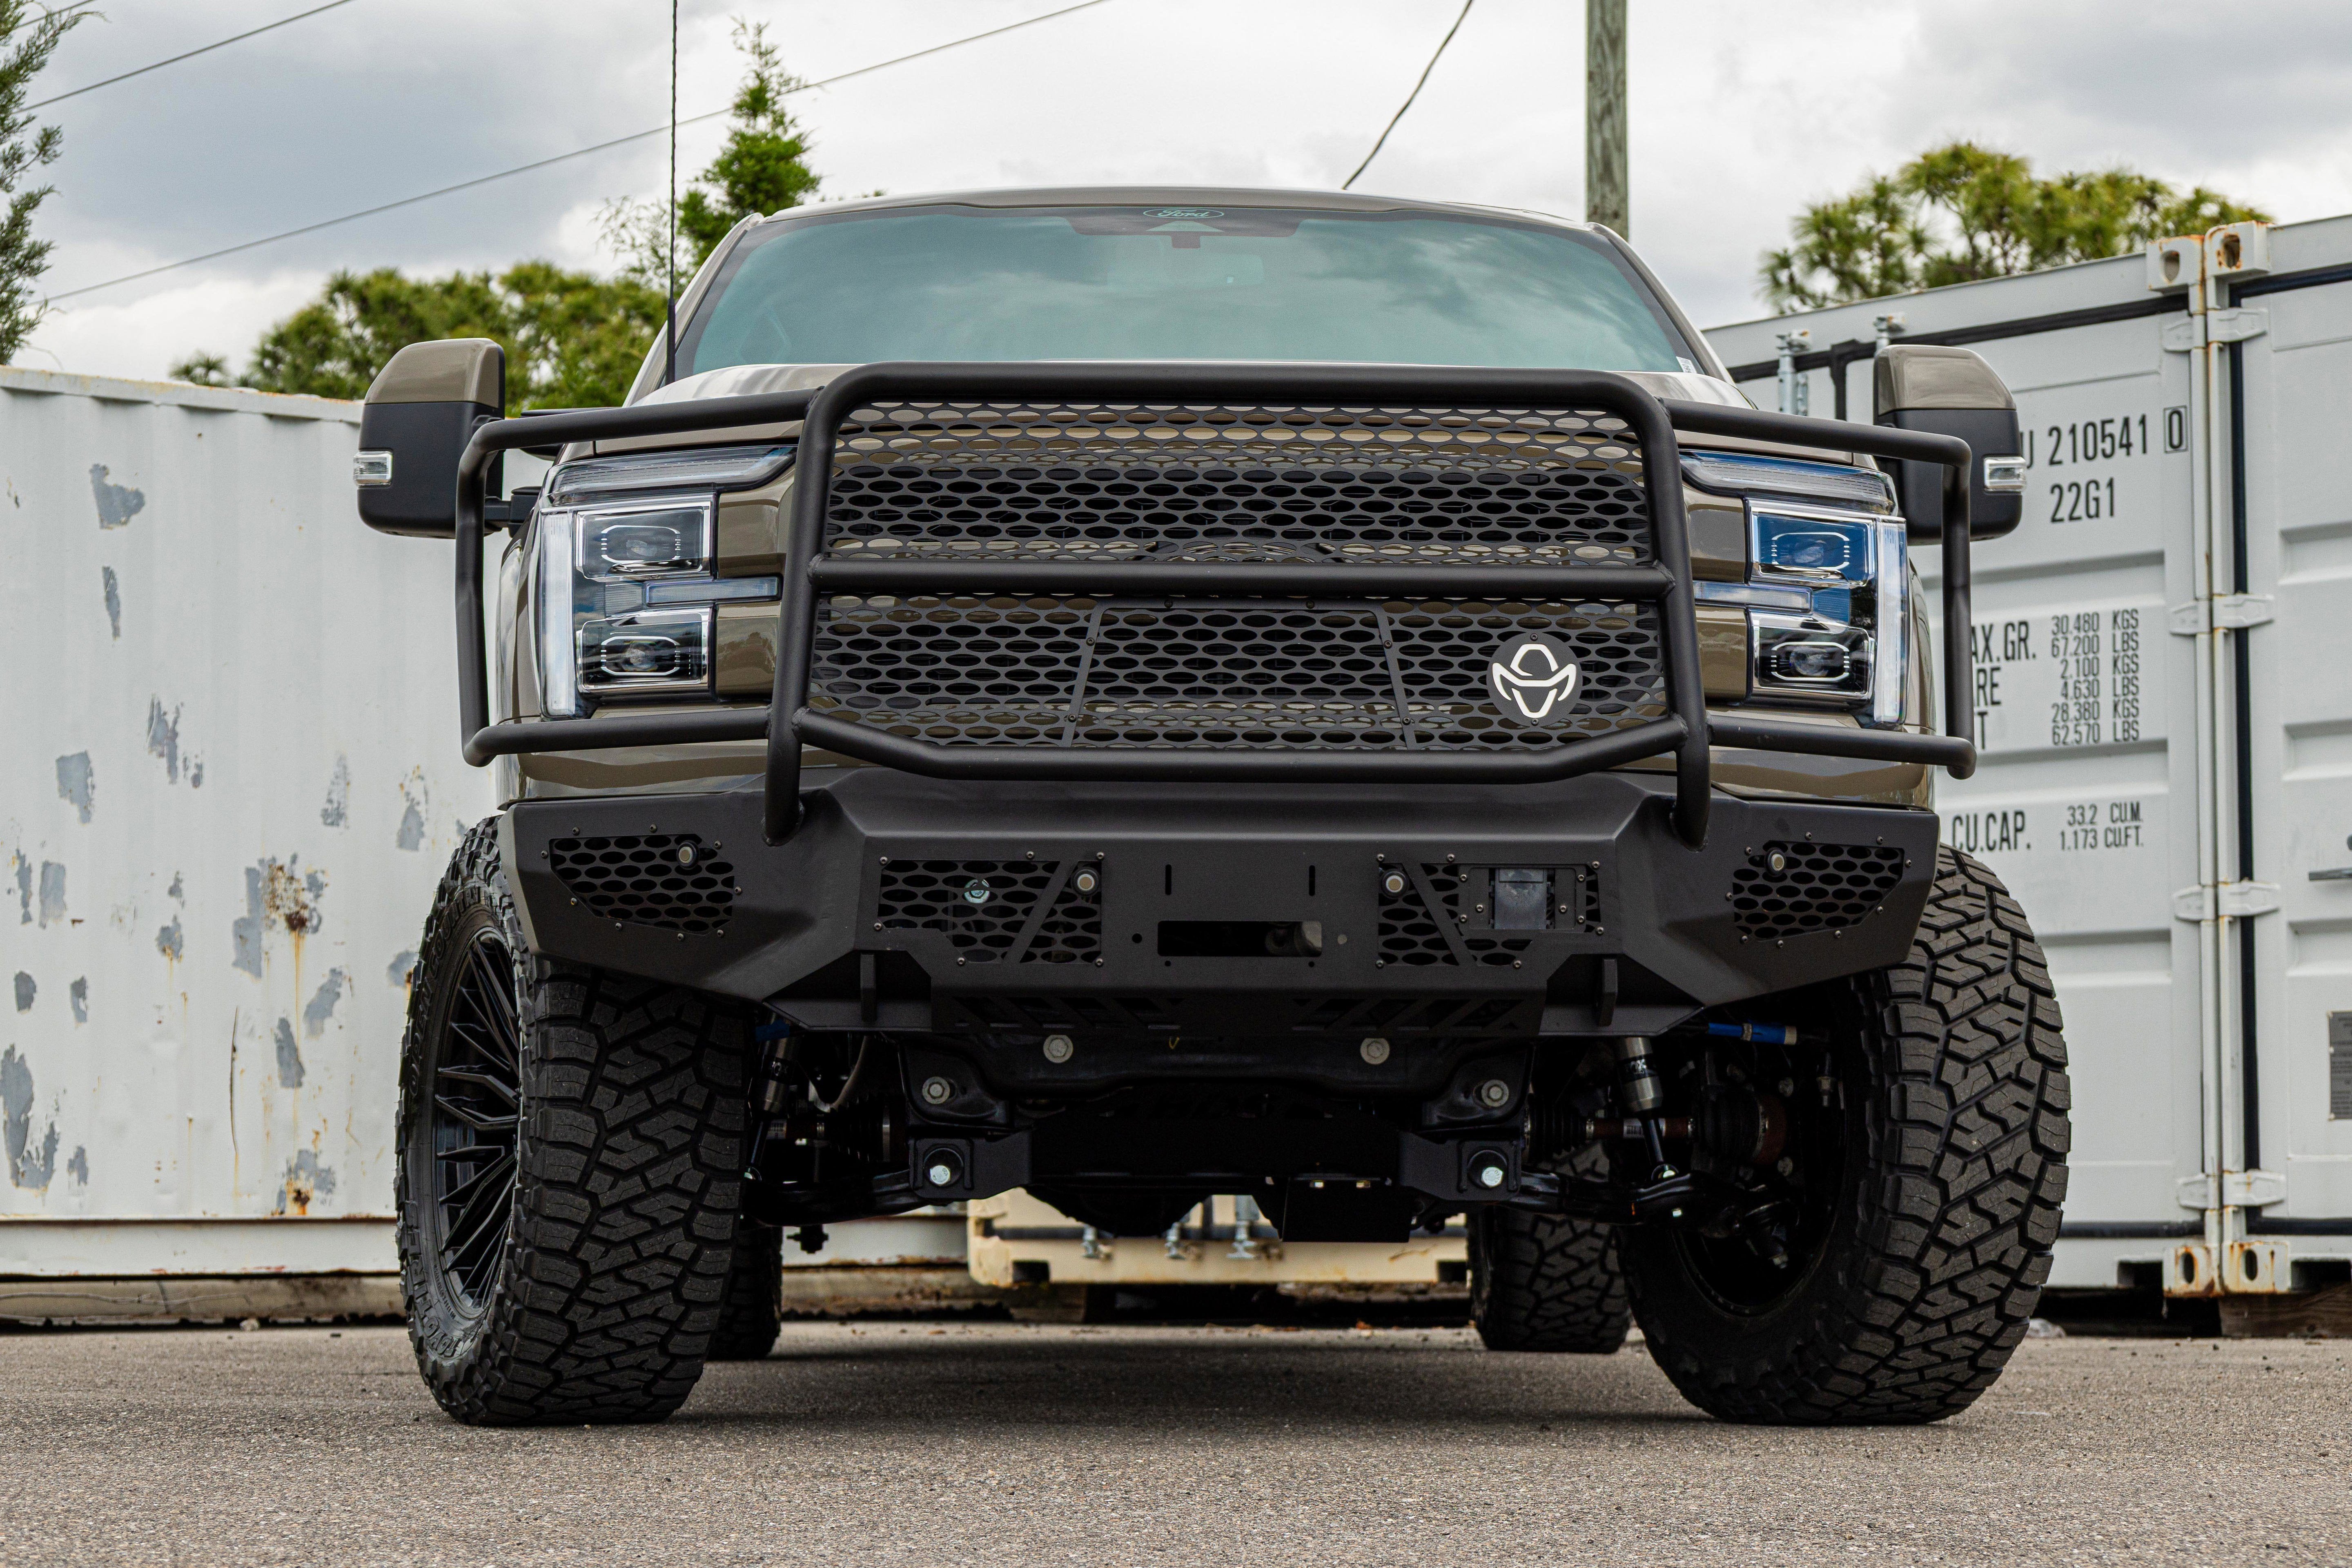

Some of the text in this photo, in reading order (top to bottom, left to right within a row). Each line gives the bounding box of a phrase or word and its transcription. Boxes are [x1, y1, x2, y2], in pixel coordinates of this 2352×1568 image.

[2048, 414, 2148, 466] 210541
[2168, 410, 2183, 450] 0
[2050, 477, 2115, 523] 22G1
[1971, 608, 2139, 664] AX.GR. 30.480 KGS
[2051, 631, 2139, 659] 67.200 LBS
[2060, 656, 2100, 679] 2.100
[2112, 653, 2139, 675] KGS
[2061, 675, 2140, 700] 4.630 LBS
[2051, 697, 2140, 723] 28.380 KGS
[2052, 719, 2140, 746] 62.570 LBS
[1952, 809, 2031, 853] CU.CAP.
[2067, 803, 2098, 827] 33.2
[2060, 828, 2098, 851] 1.173
[409, 976, 433, 1098] OPEN
[423, 1314, 462, 1357] TOYO
